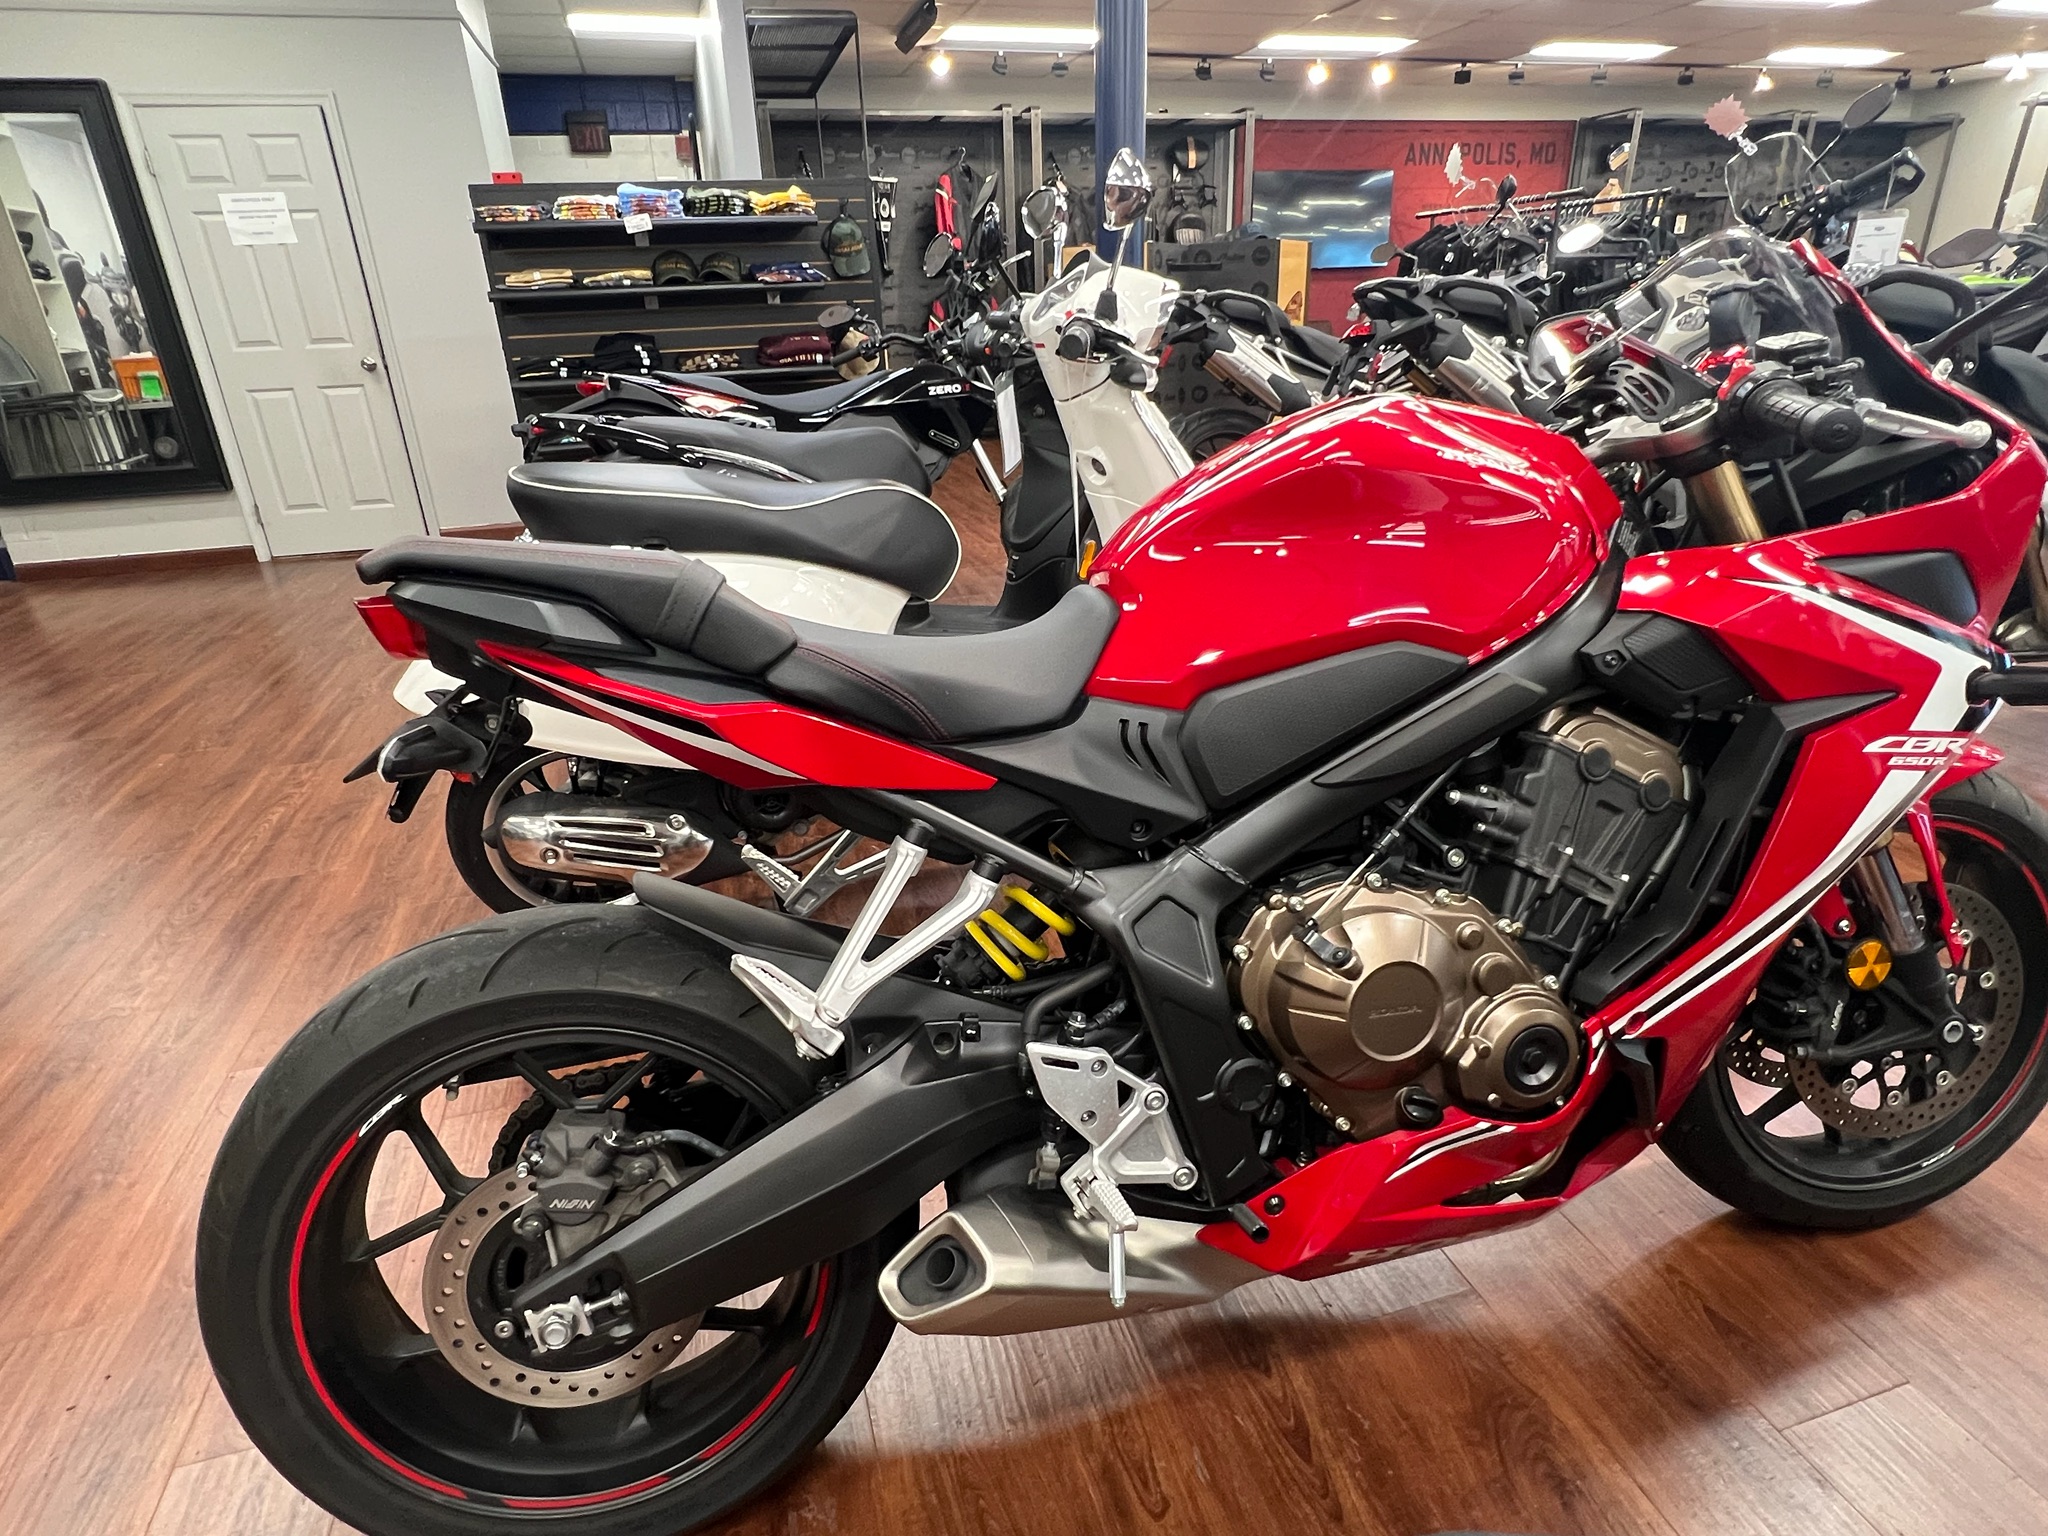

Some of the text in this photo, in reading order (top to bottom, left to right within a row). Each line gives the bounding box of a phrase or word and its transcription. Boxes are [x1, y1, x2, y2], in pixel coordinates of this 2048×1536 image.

[1404, 142, 1557, 168] ANNPOLIS, MD
[928, 383, 962, 396] ZERO
[1862, 735, 1969, 755] CBR
